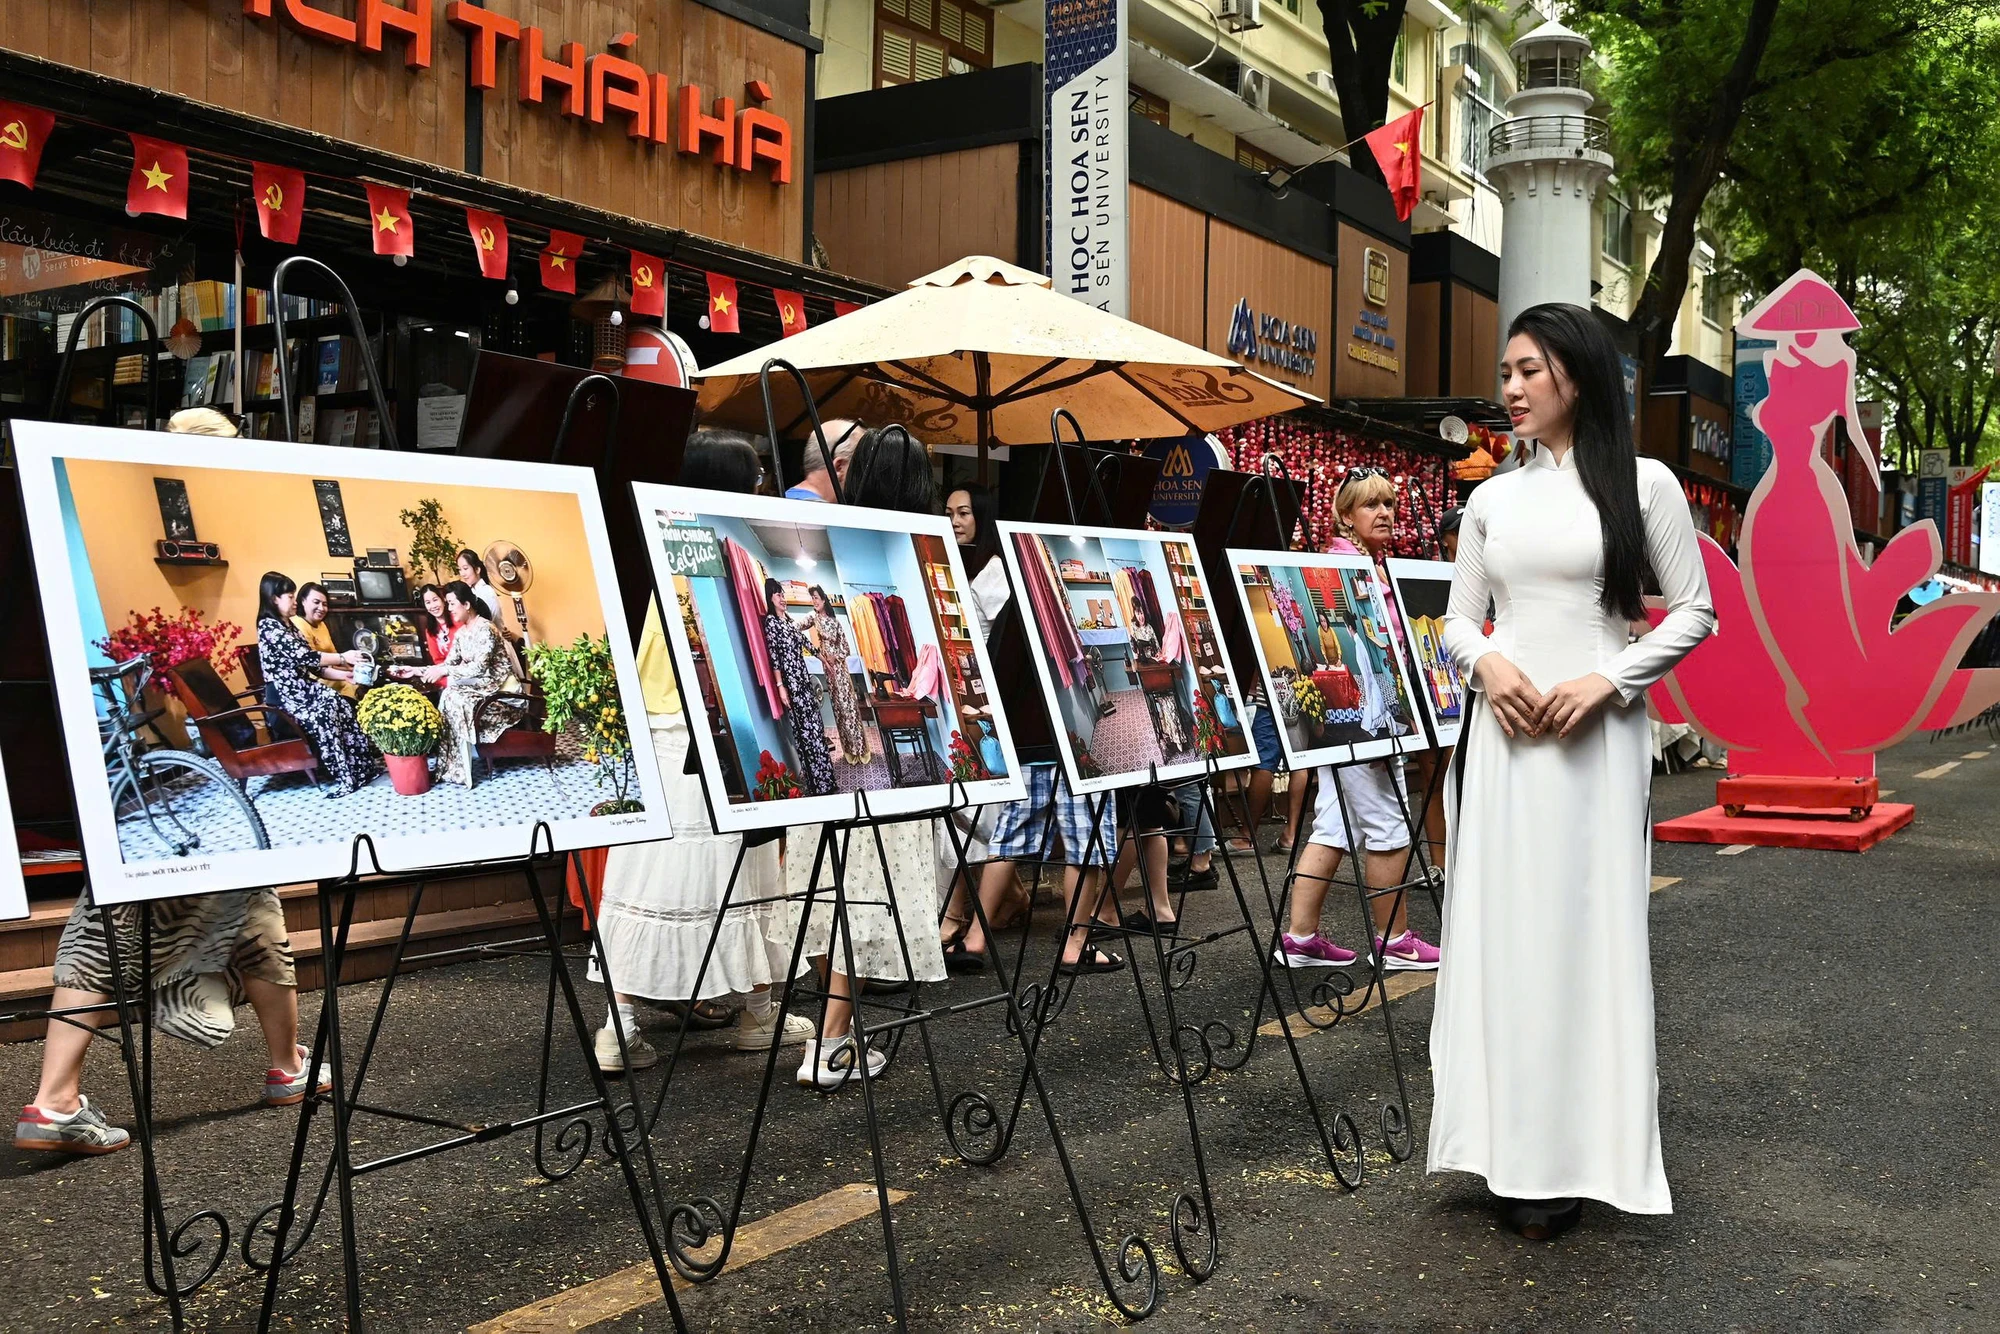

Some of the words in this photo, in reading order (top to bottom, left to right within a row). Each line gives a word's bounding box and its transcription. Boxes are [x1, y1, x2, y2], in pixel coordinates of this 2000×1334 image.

[447, 0, 668, 145] THÁI
[678, 80, 791, 185] HÀ
[1071, 90, 1089, 143] SEN
[1096, 75, 1110, 226] UNIVERSITY
[1071, 150, 1089, 218] HOA
[45, 260, 68, 273] Serve
[70, 258, 79, 268] to
[1071, 225, 1095, 294] HỌC
[1096, 240, 1110, 287] SEN
[1259, 313, 1291, 345] HOA
[1292, 325, 1316, 354] SEN
[1258, 343, 1315, 376] UNIVERSITY
[1153, 480, 1178, 491] HOA
[1182, 480, 1202, 491] SEN
[1153, 492, 1201, 501] UNIVERSITY
